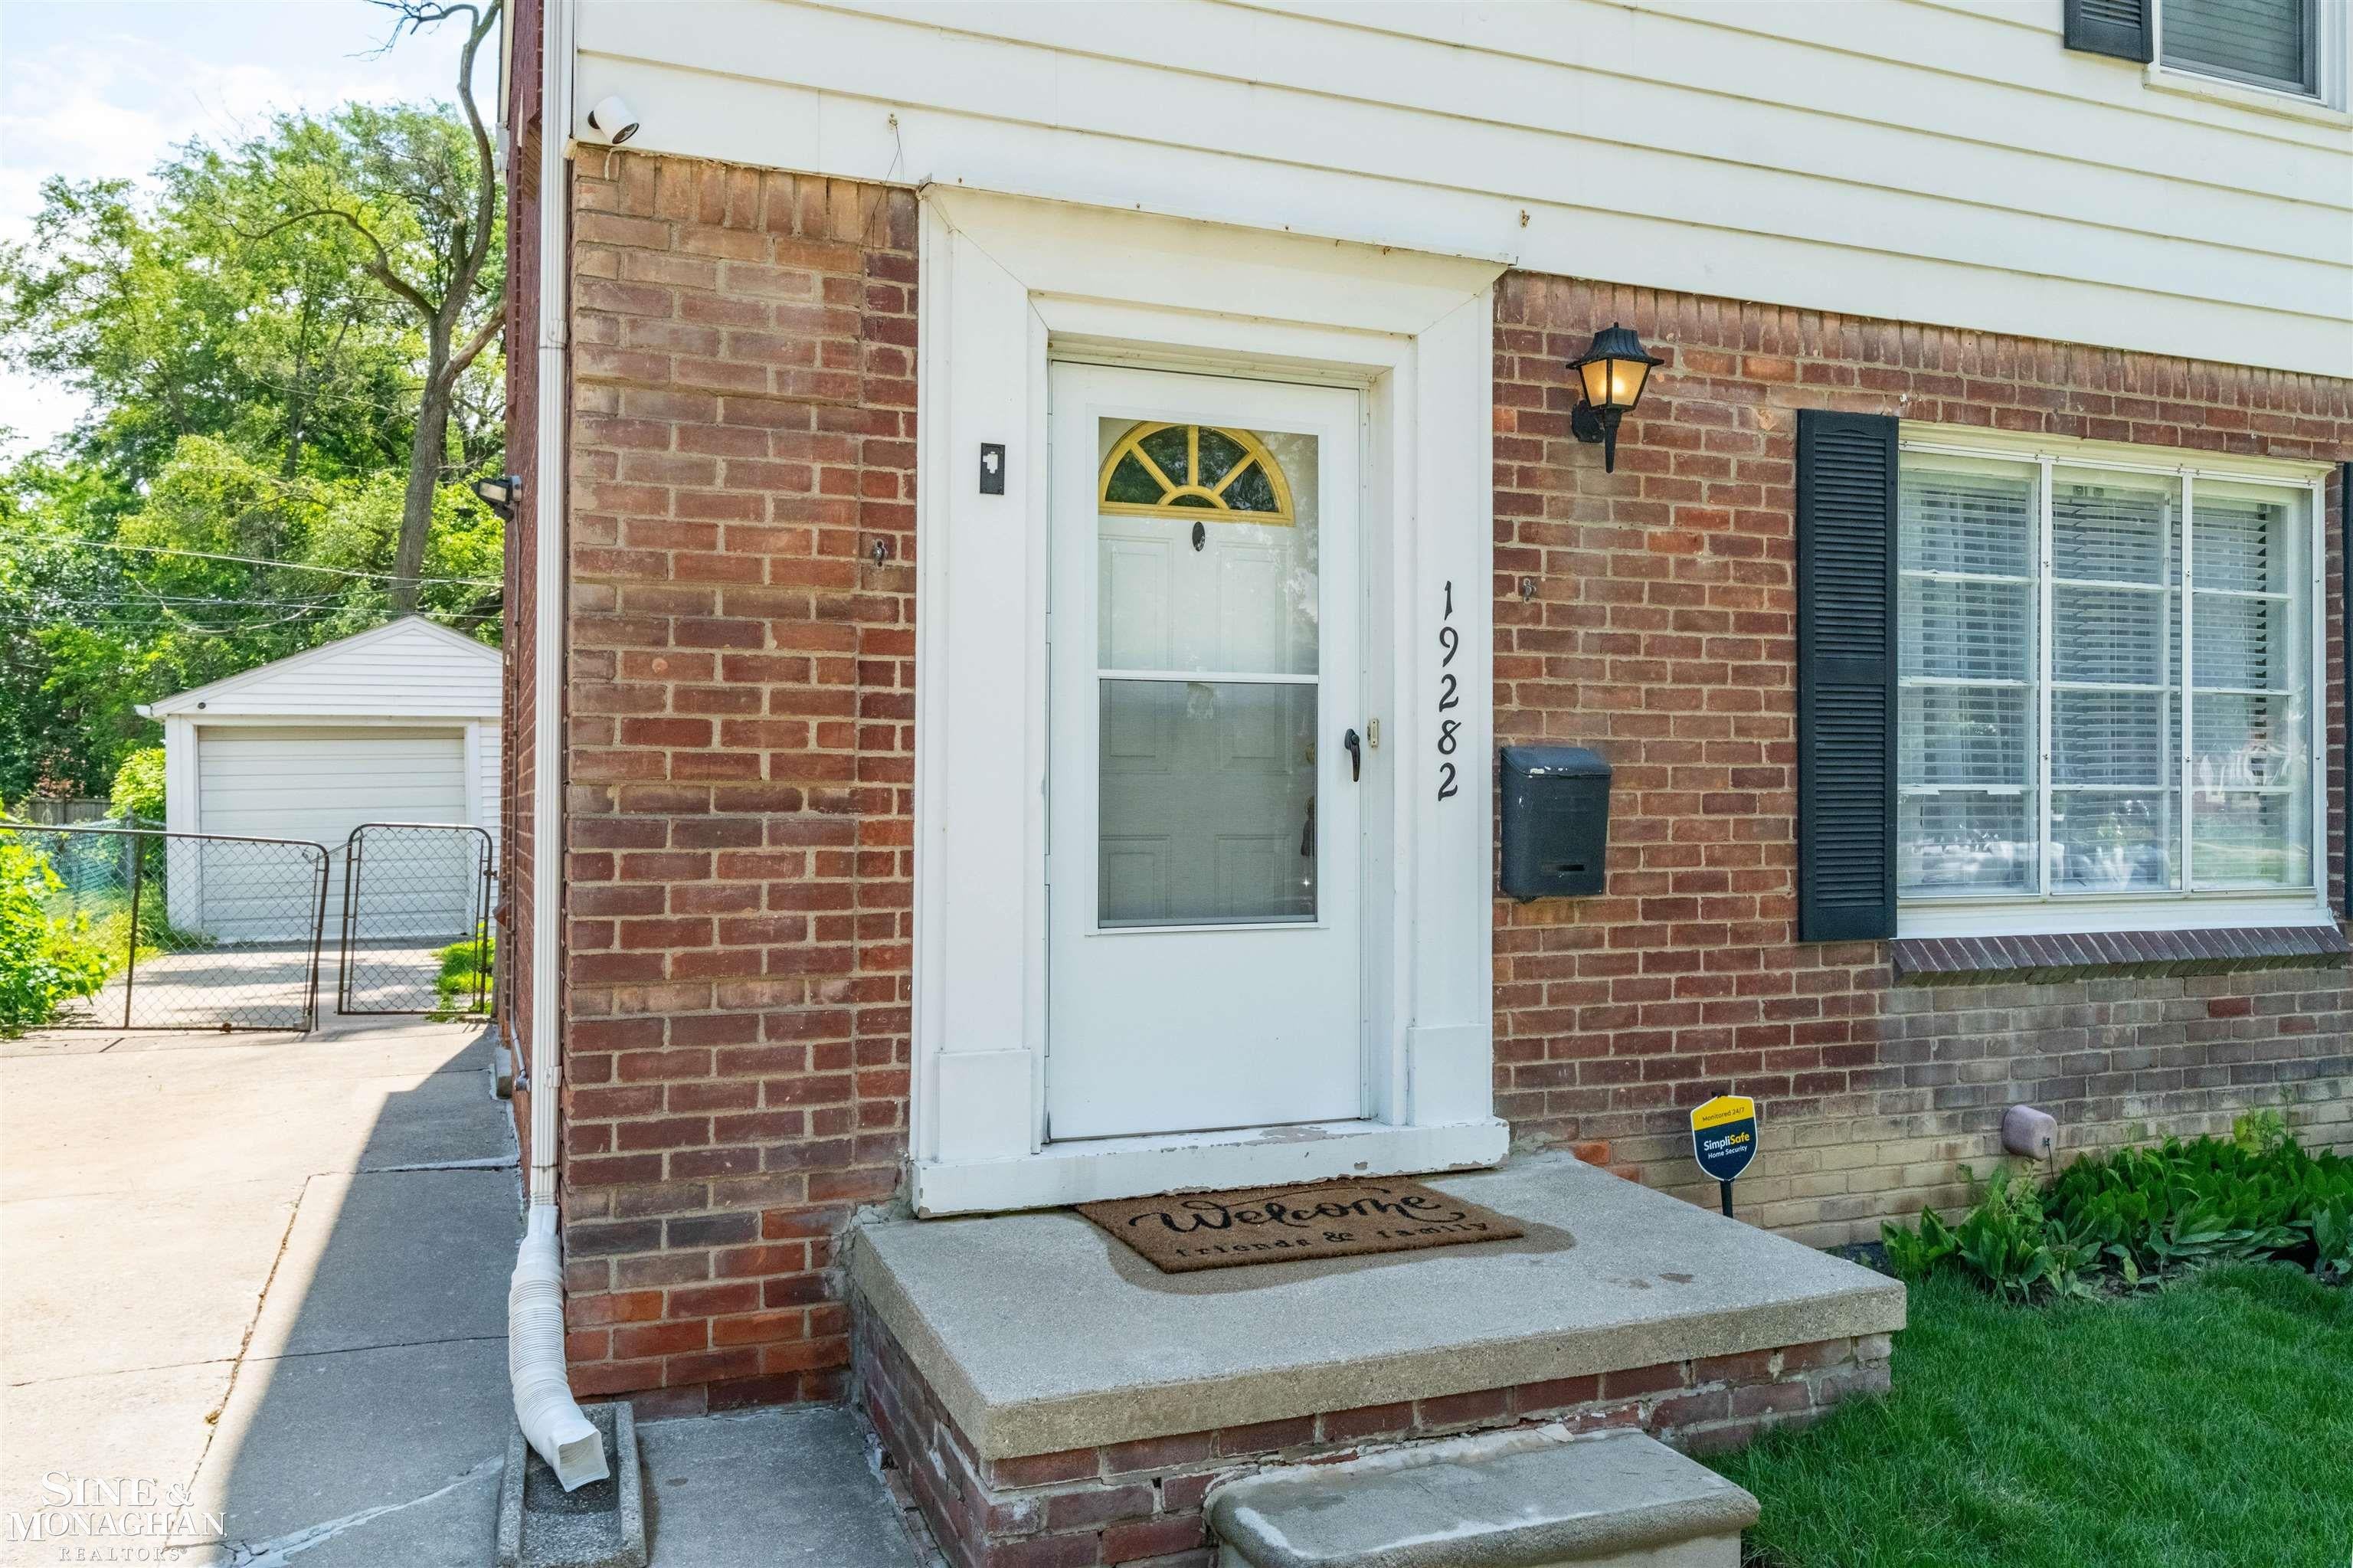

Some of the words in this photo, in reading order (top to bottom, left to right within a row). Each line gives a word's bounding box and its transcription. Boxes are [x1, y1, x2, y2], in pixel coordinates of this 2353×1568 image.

[1438, 581, 1461, 802] 19282
[1703, 1109, 1732, 1121] Monitored
[1703, 1133, 1749, 1151] SimpliSafe
[1725, 1145, 1747, 1155] Security
[1128, 1187, 1466, 1234] Welcome
